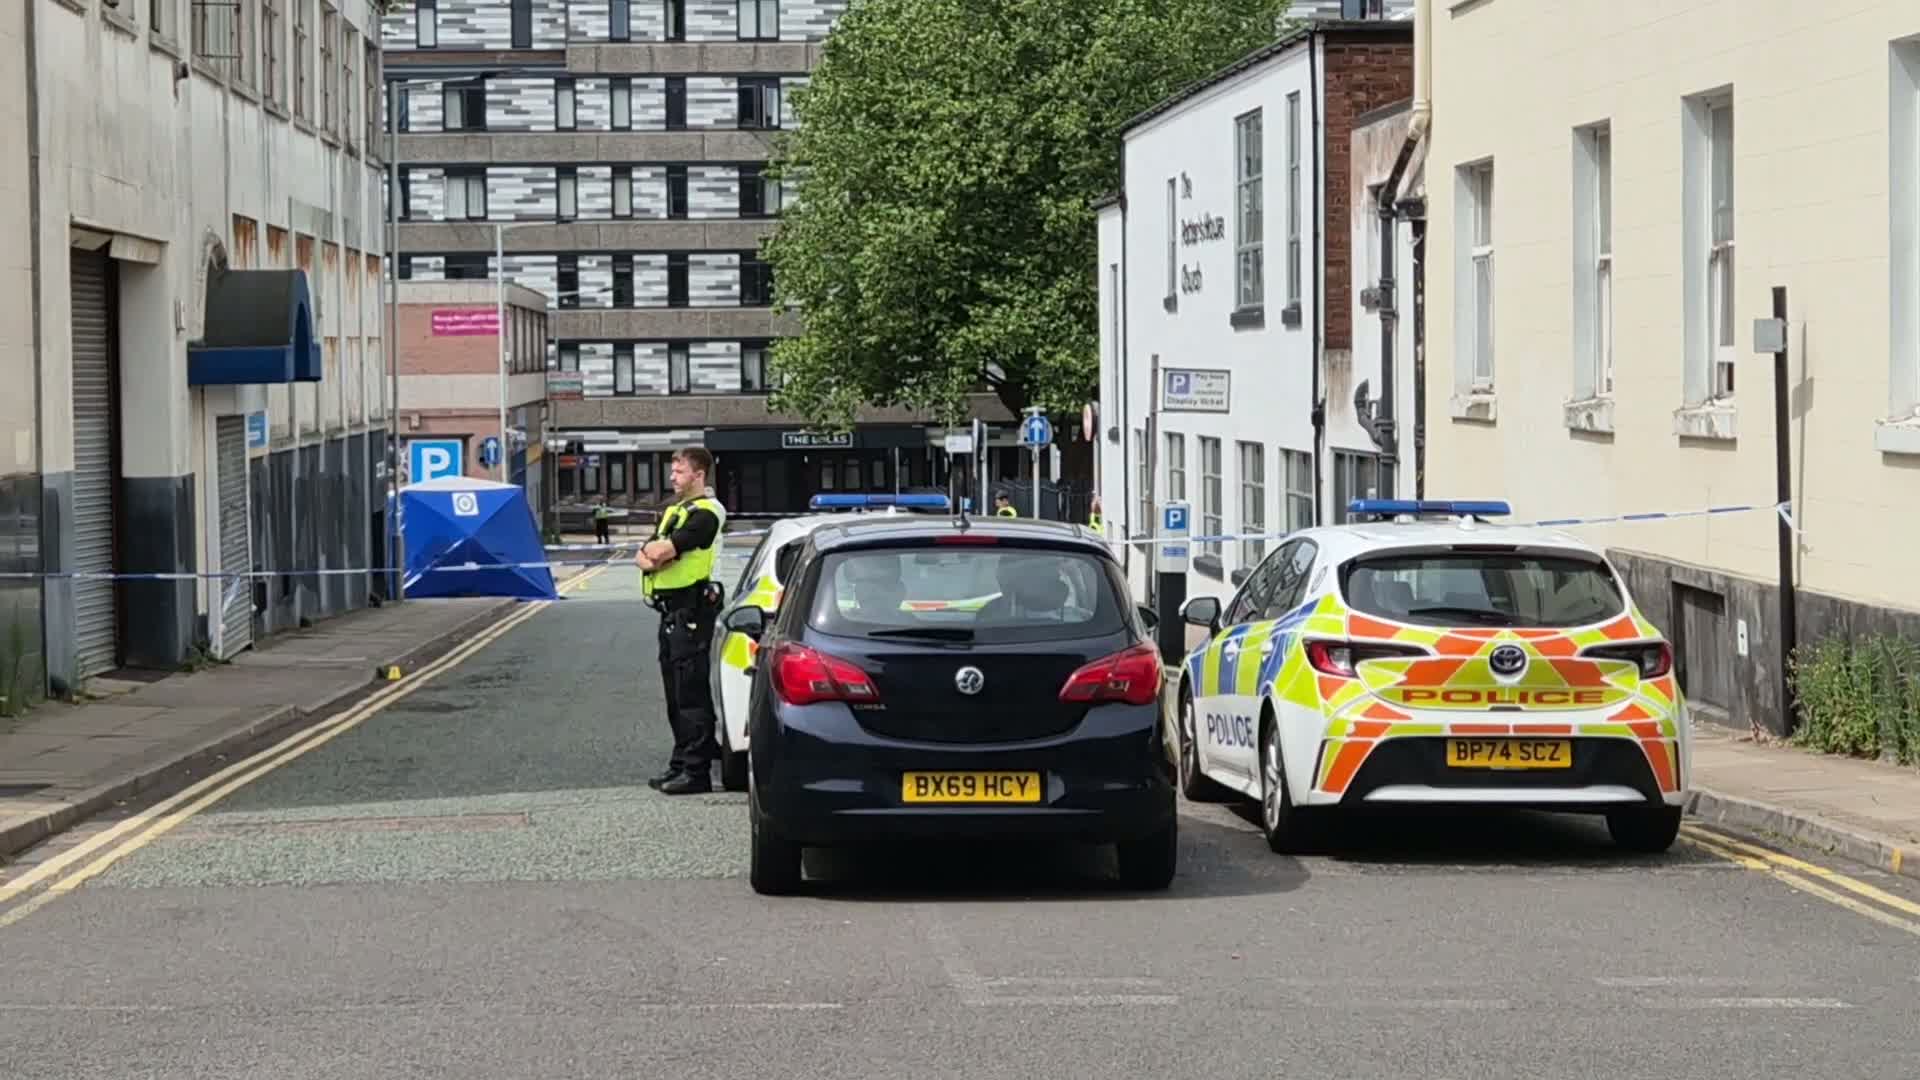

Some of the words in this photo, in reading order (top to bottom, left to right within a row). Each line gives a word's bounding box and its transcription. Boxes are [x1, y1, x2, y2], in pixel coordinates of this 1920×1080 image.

[1173, 375, 1186, 393] P
[788, 436, 809, 444] THE
[421, 447, 451, 482] P
[1169, 510, 1182, 528] P
[1402, 689, 1604, 704] POLICE
[1207, 713, 1255, 749] POLICE
[1456, 741, 1512, 761] BP74
[1519, 742, 1561, 761] SCZ
[914, 775, 977, 797] BX69
[983, 775, 1030, 797] HCY
